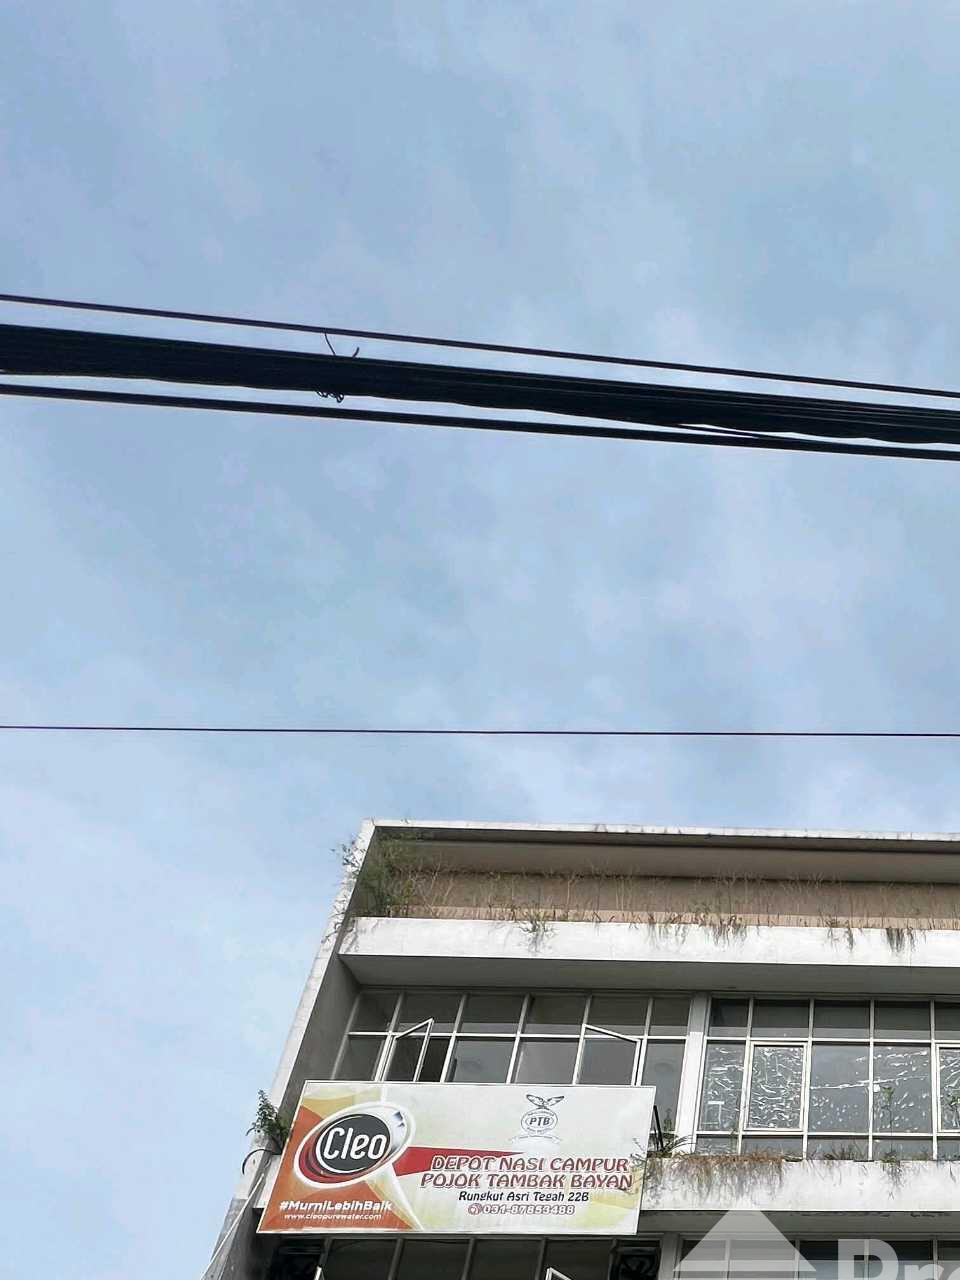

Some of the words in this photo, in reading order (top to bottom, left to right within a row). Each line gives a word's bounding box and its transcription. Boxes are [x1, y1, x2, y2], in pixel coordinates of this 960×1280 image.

[529, 1116, 550, 1126] PTB
[322, 1126, 386, 1160] Cleo
[431, 1156, 495, 1172] DEPOT
[499, 1157, 545, 1172] NASI
[550, 1157, 629, 1173] CAMPUR
[420, 1173, 483, 1188] POJOK
[486, 1174, 566, 1189] TAMBAK
[570, 1174, 633, 1189] BAYAN
[459, 1191, 504, 1202] Rungkut
[507, 1191, 530, 1202] Asri
[533, 1191, 565, 1202] Tegah
[568, 1192, 590, 1202] 22B
[279, 1200, 393, 1212] #MurniLebihBaik
[483, 1204, 576, 1215] 031-87853488
[284, 1212, 382, 1221] www.cleopurewater.com
